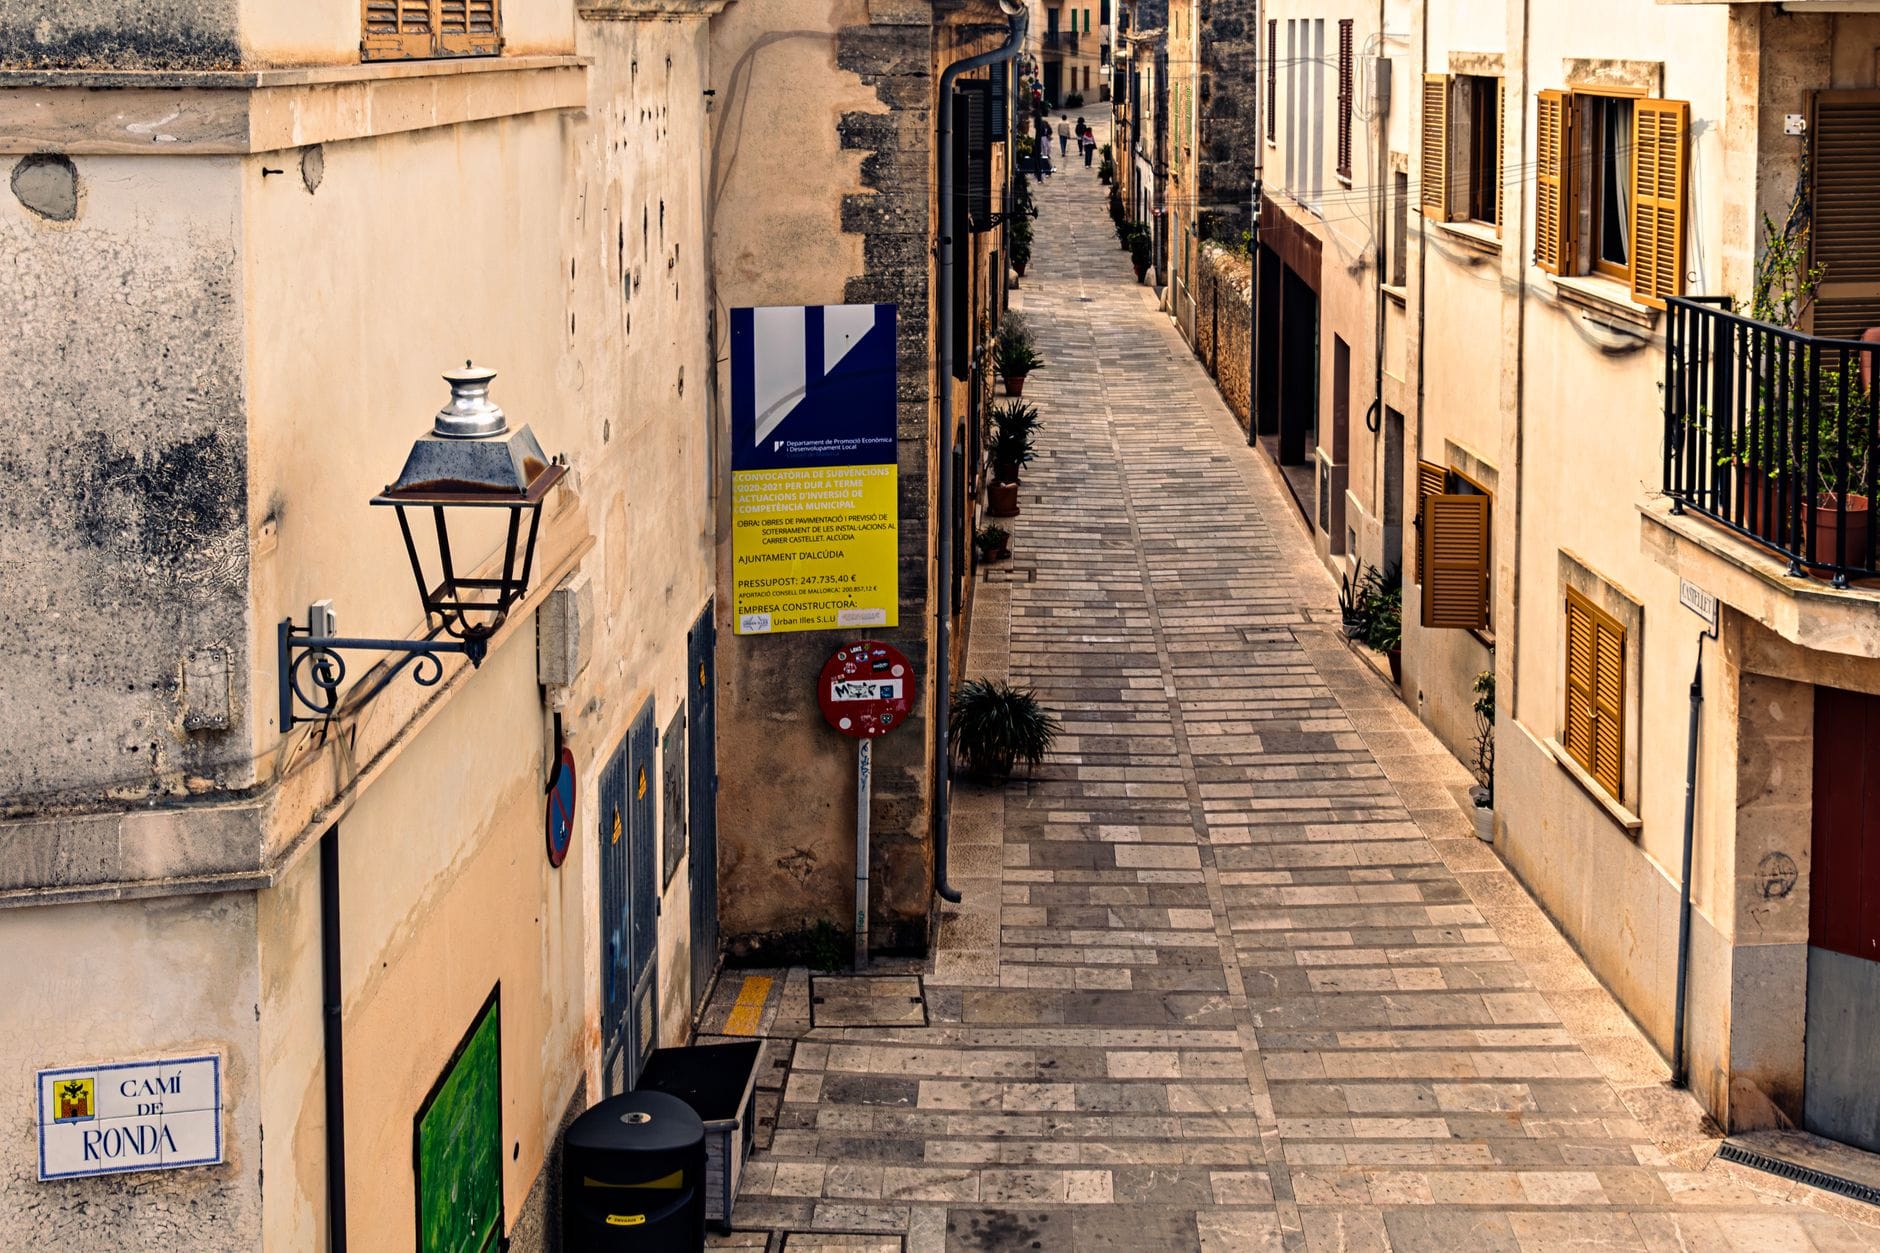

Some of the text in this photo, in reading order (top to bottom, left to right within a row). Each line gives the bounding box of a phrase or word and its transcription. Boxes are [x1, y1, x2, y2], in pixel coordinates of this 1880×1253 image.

[826, 468, 889, 478] SUBVENCIONS
[834, 480, 863, 488] TERME
[739, 493, 796, 503] ACTUACIONS
[806, 501, 855, 510] MUNICIPAL
[762, 527, 810, 535] SOTERRAMENT
[738, 553, 798, 564] AJUNTAMENT
[738, 578, 798, 588] PRESSUPOST:
[738, 600, 857, 614] EMPRESA CONSTRUCTORA:
[774, 617, 797, 626] Urban
[120, 1070, 182, 1097] CAMÍ
[137, 1102, 163, 1116] DE
[83, 1124, 178, 1161] RONDA
